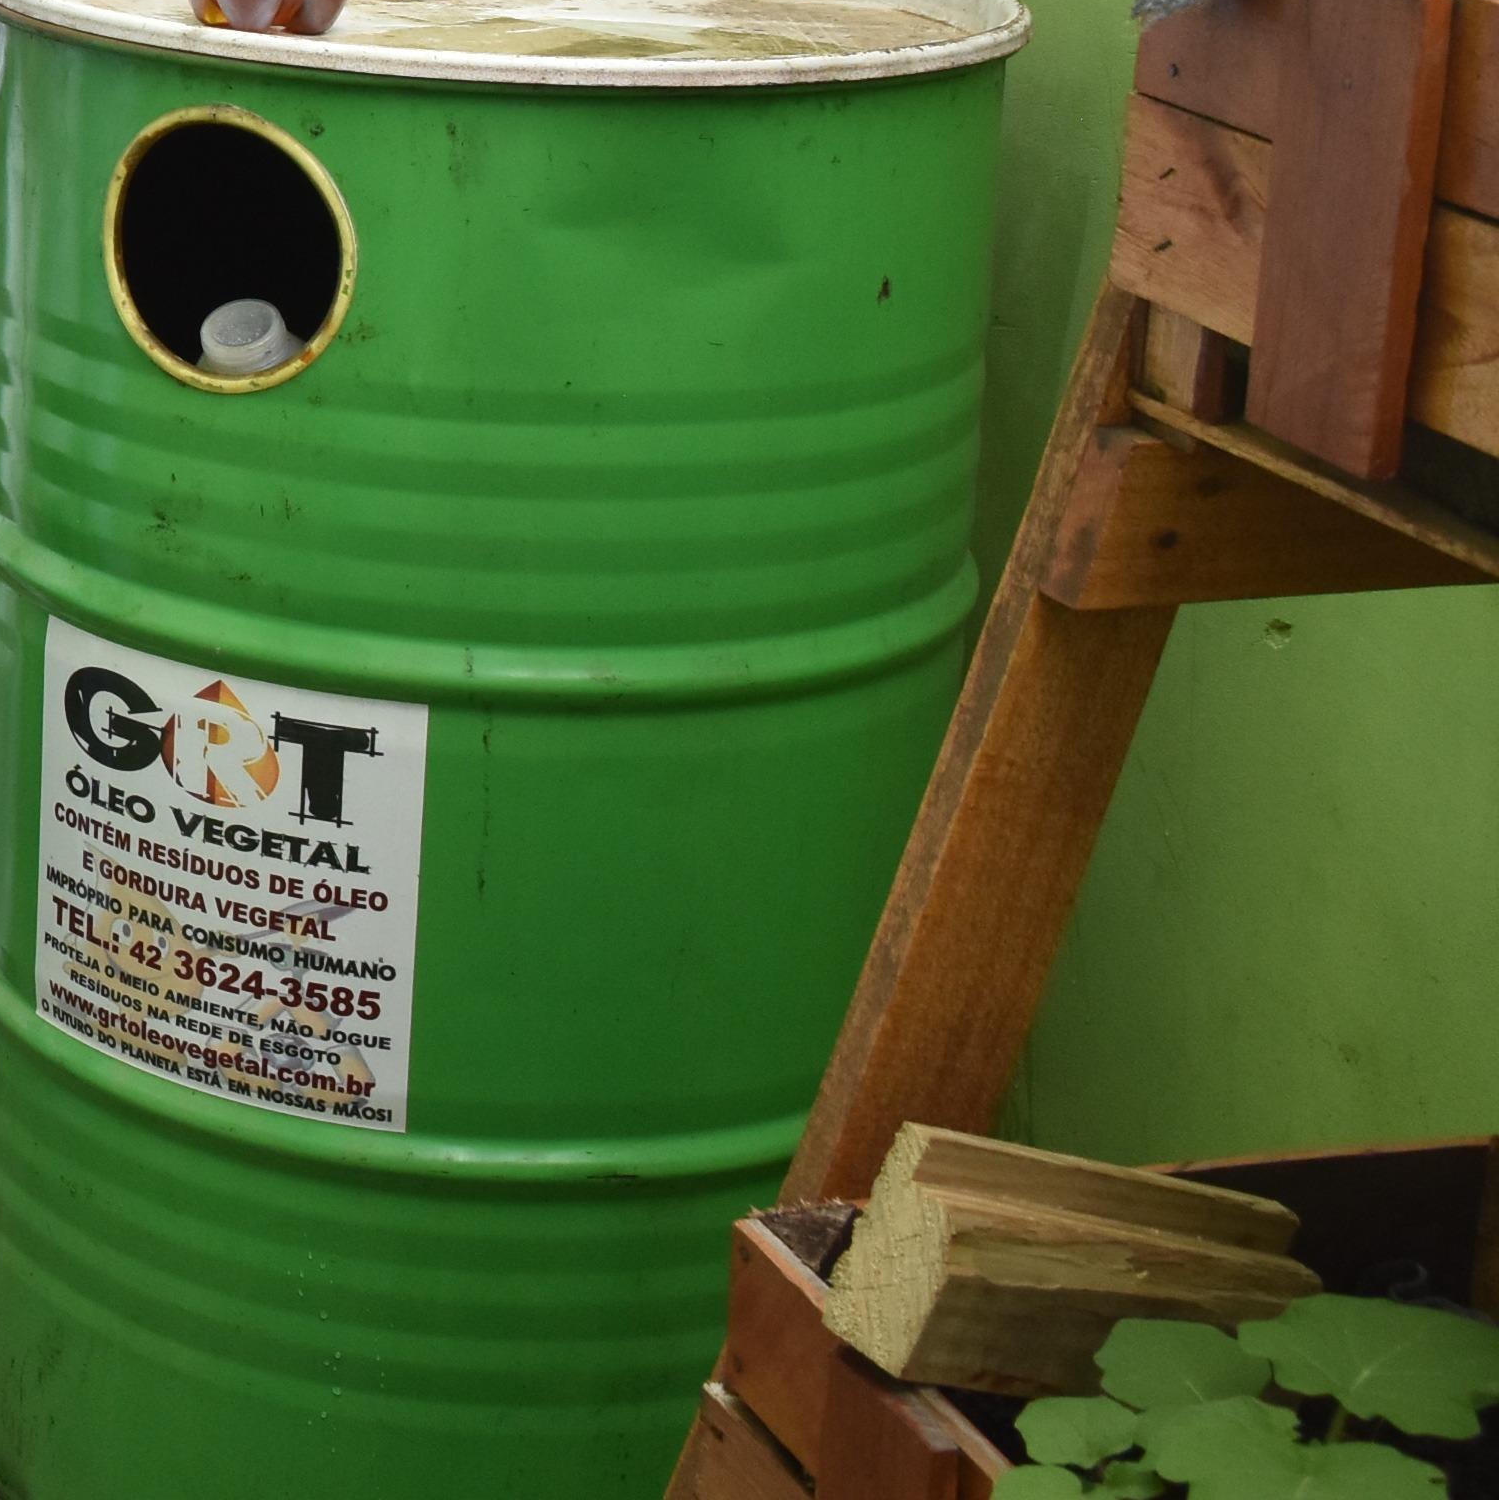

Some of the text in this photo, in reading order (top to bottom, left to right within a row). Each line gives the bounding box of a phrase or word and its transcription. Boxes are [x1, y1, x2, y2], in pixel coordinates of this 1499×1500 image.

[65, 666, 384, 828] GRT
[55, 802, 389, 912] CONTÉM RESÍDUOS DE ÓLEO
[65, 764, 372, 875] ÓLEO VEGETAL
[46, 863, 396, 982] IMPRÓPRIO PARA CONSUMO HUMANO
[83, 850, 336, 942] E GORDURA VEGETAL
[44, 932, 392, 1050] PROTEJA O MEIO AMBIENTE, NÃO JOGUE
[52, 895, 381, 1021] TEL.: 42 3624-3585
[41, 998, 50, 1012] O
[53, 1005, 94, 1037] FUTURO
[98, 1029, 117, 1048] DO
[121, 1040, 181, 1076] PLANETA
[186, 1067, 222, 1089] ESTÁ
[228, 1079, 251, 1097] EM
[257, 1087, 326, 1113] NOSSAS
[49, 979, 376, 1098] www.grtoleovegetal.com.br
[70, 969, 341, 1066] RESÍDUOS NA REDE DE ESGOTO
